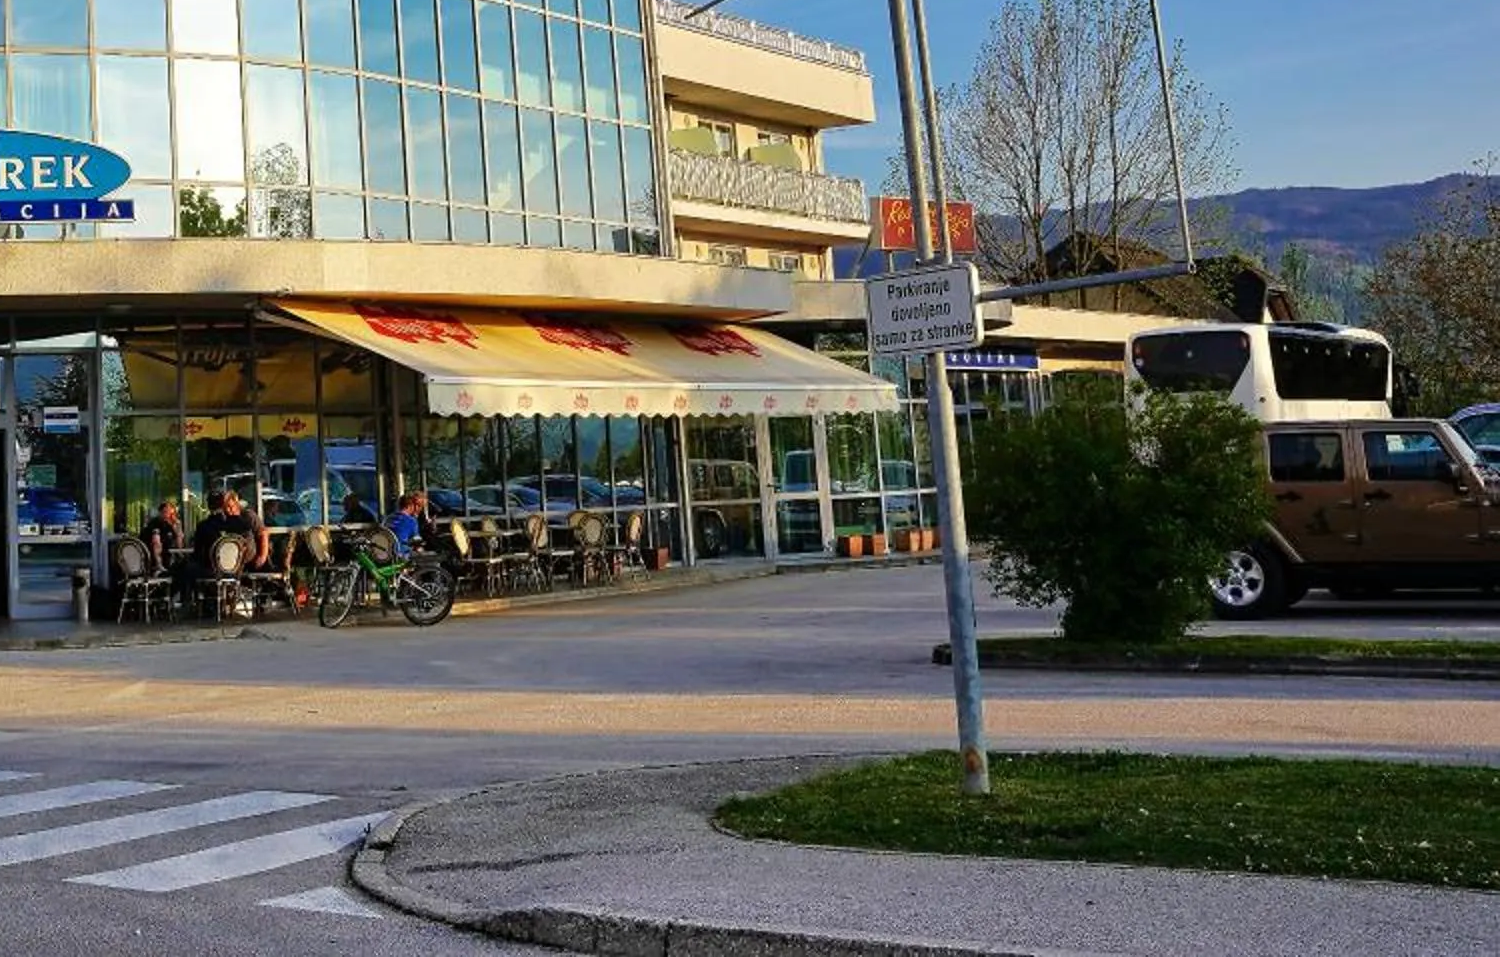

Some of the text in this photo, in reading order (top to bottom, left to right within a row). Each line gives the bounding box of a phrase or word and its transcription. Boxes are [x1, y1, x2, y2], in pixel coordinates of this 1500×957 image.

[887, 277, 951, 299] Parkiranje
[891, 302, 951, 321] dovoljeno
[875, 319, 973, 347] samo za stranke
